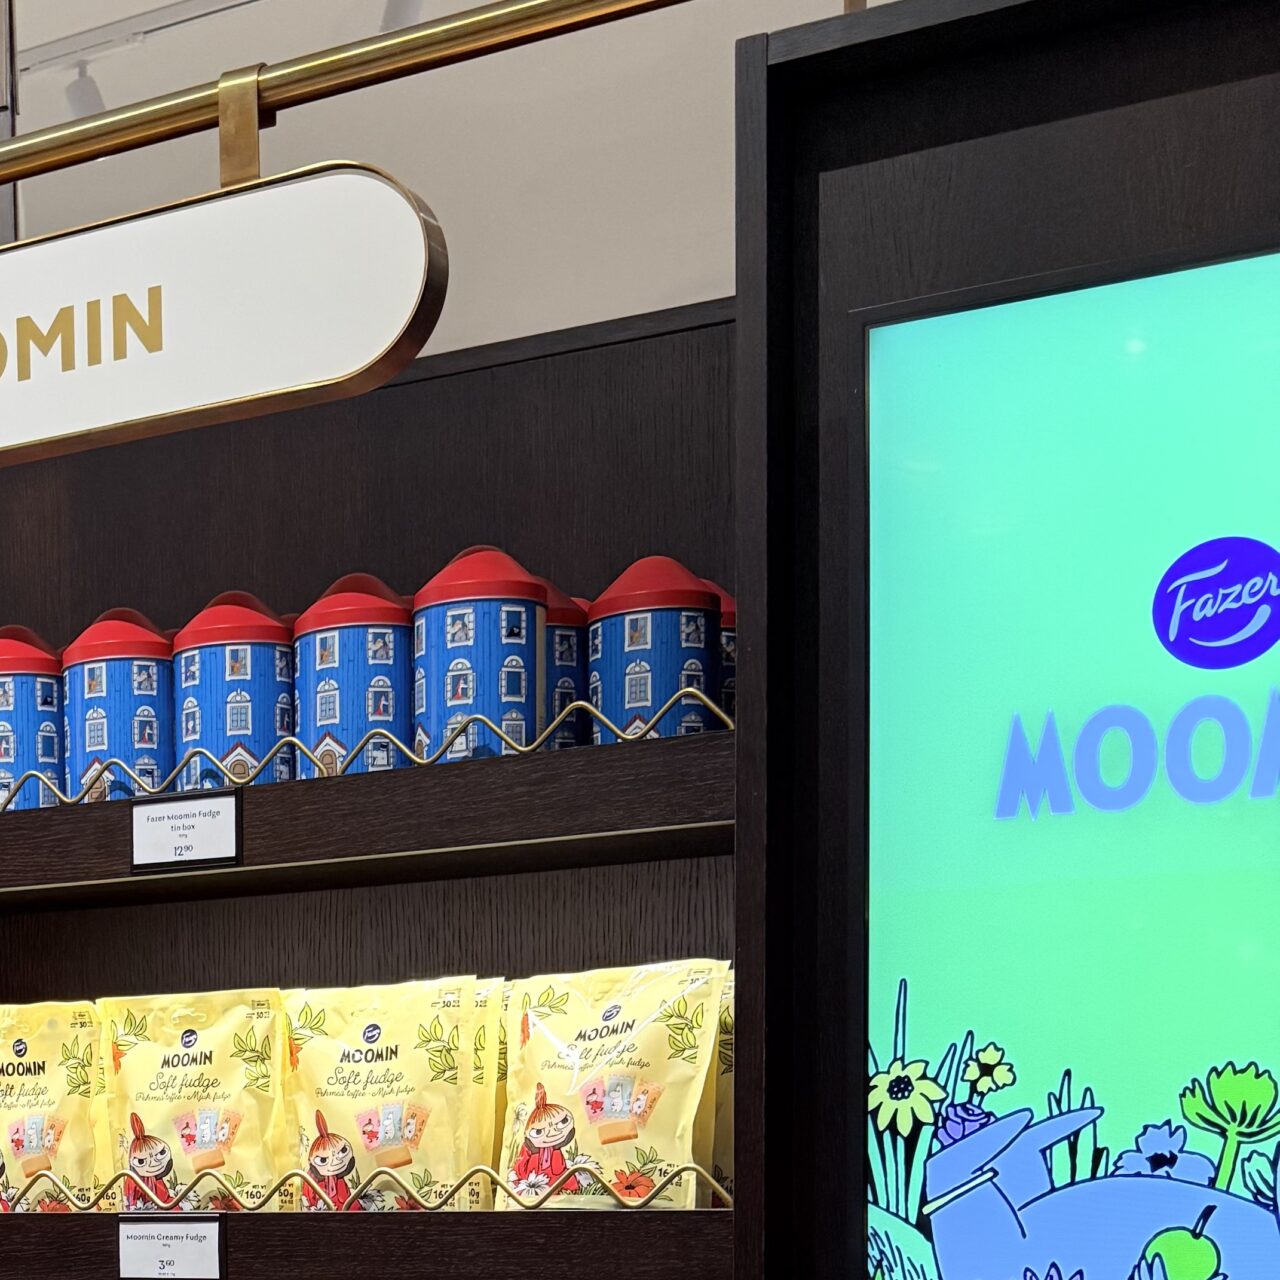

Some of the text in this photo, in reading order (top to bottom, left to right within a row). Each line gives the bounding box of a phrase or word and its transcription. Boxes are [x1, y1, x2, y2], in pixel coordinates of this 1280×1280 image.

[1167, 559, 1280, 641] Fazer
[167, 812, 197, 821] Moomin
[198, 809, 221, 819] Fudge
[574, 1020, 636, 1043] MOOMIN
[161, 1051, 213, 1069] MOOMIN
[149, 1073, 221, 1094] Soft fudge
[327, 1067, 404, 1087] Soft fudge
[16, 1081, 49, 1099] fudge
[157, 1233, 184, 1243] Creamy
[186, 1233, 207, 1243] Fudge
